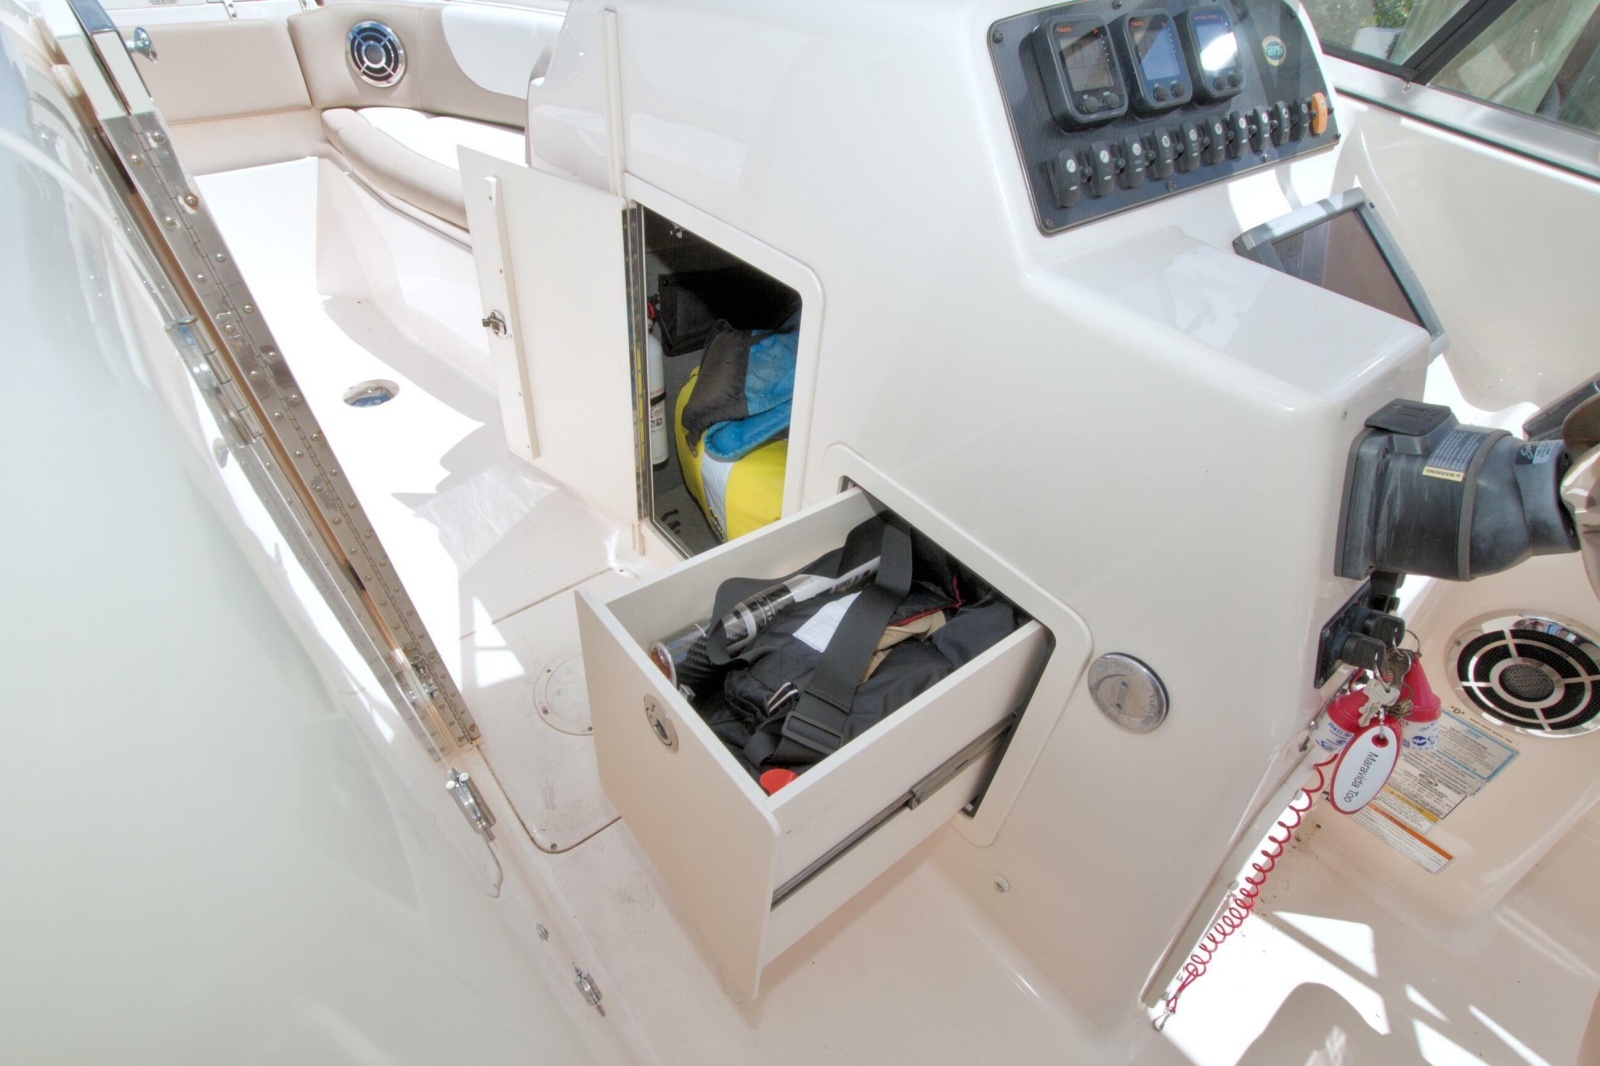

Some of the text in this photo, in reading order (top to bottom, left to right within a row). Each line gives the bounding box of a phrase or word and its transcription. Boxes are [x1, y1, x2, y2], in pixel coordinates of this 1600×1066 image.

[1425, 468, 1455, 477] WARNING
[1343, 751, 1379, 803] Maravida Too
